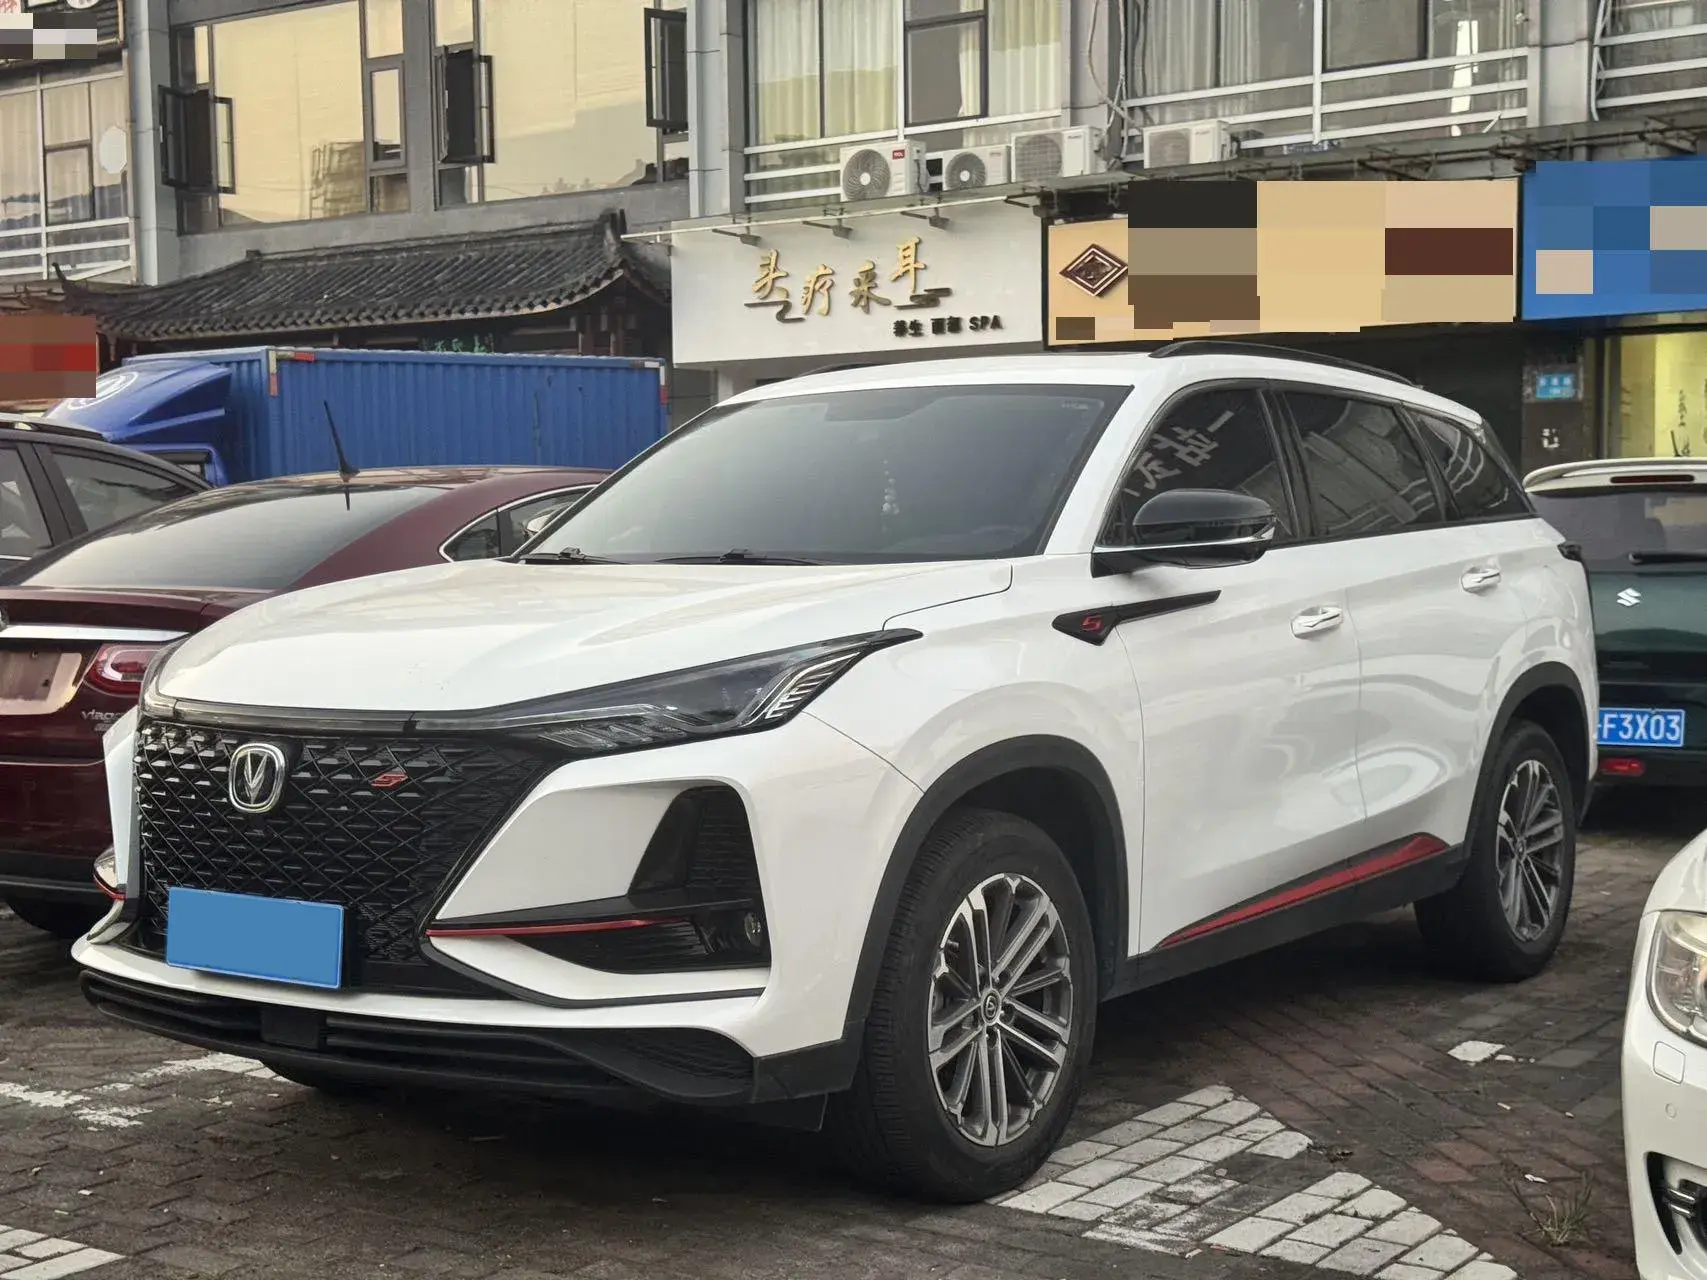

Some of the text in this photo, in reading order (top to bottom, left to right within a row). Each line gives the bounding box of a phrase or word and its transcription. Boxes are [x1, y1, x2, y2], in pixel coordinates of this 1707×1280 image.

[753, 236, 927, 315] 头疗采耳
[969, 315, 1004, 331] SPA
[1603, 713, 1681, 741] F3X03
